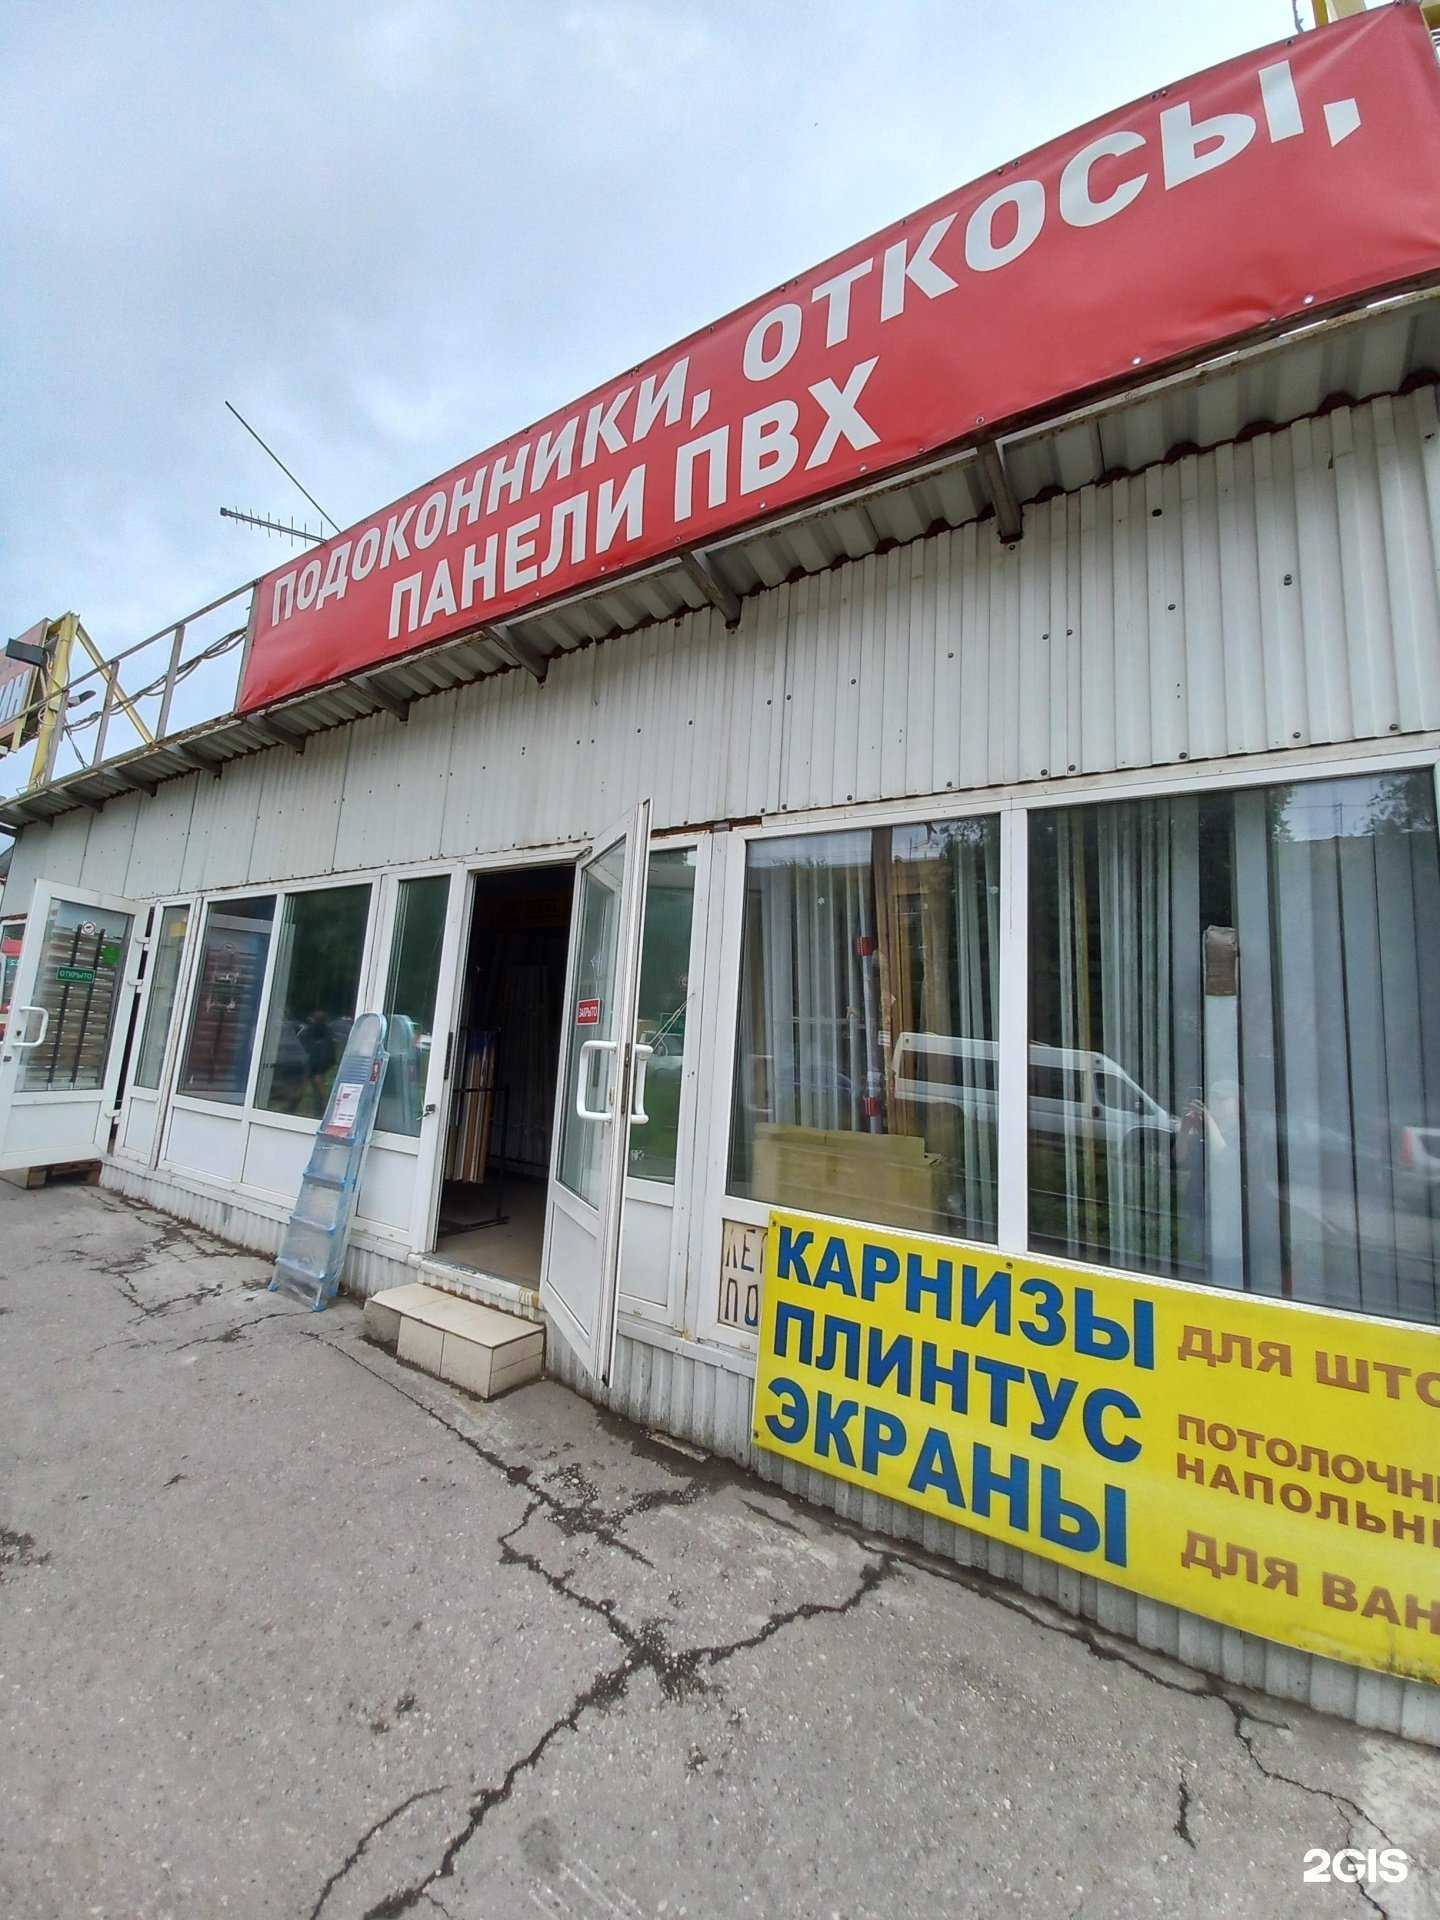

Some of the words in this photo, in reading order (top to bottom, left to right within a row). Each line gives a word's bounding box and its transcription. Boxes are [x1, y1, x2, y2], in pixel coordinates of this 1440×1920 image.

[272, 356, 711, 627] ПОДОКОННИКИ,
[742, 59, 1361, 382] ОТКОСЫ,
[388, 464, 646, 640] ПАНЕЛИ
[674, 356, 881, 522] ПВХ
[776, 1226, 1155, 1370] КАРНИЗЫ
[1178, 1325, 1292, 1377] ДЛЯ
[773, 1300, 1143, 1463] ПЛИНТУС
[764, 1377, 1128, 1569] ЭКРАНЫ
[1177, 1453, 1440, 1549] НАПОЛЬН
[1178, 1414, 1440, 1504] ПОТОЛОЧН
[1181, 1529, 1299, 1597] ДЛЯ
[1322, 1572, 1440, 1636] ВАН
